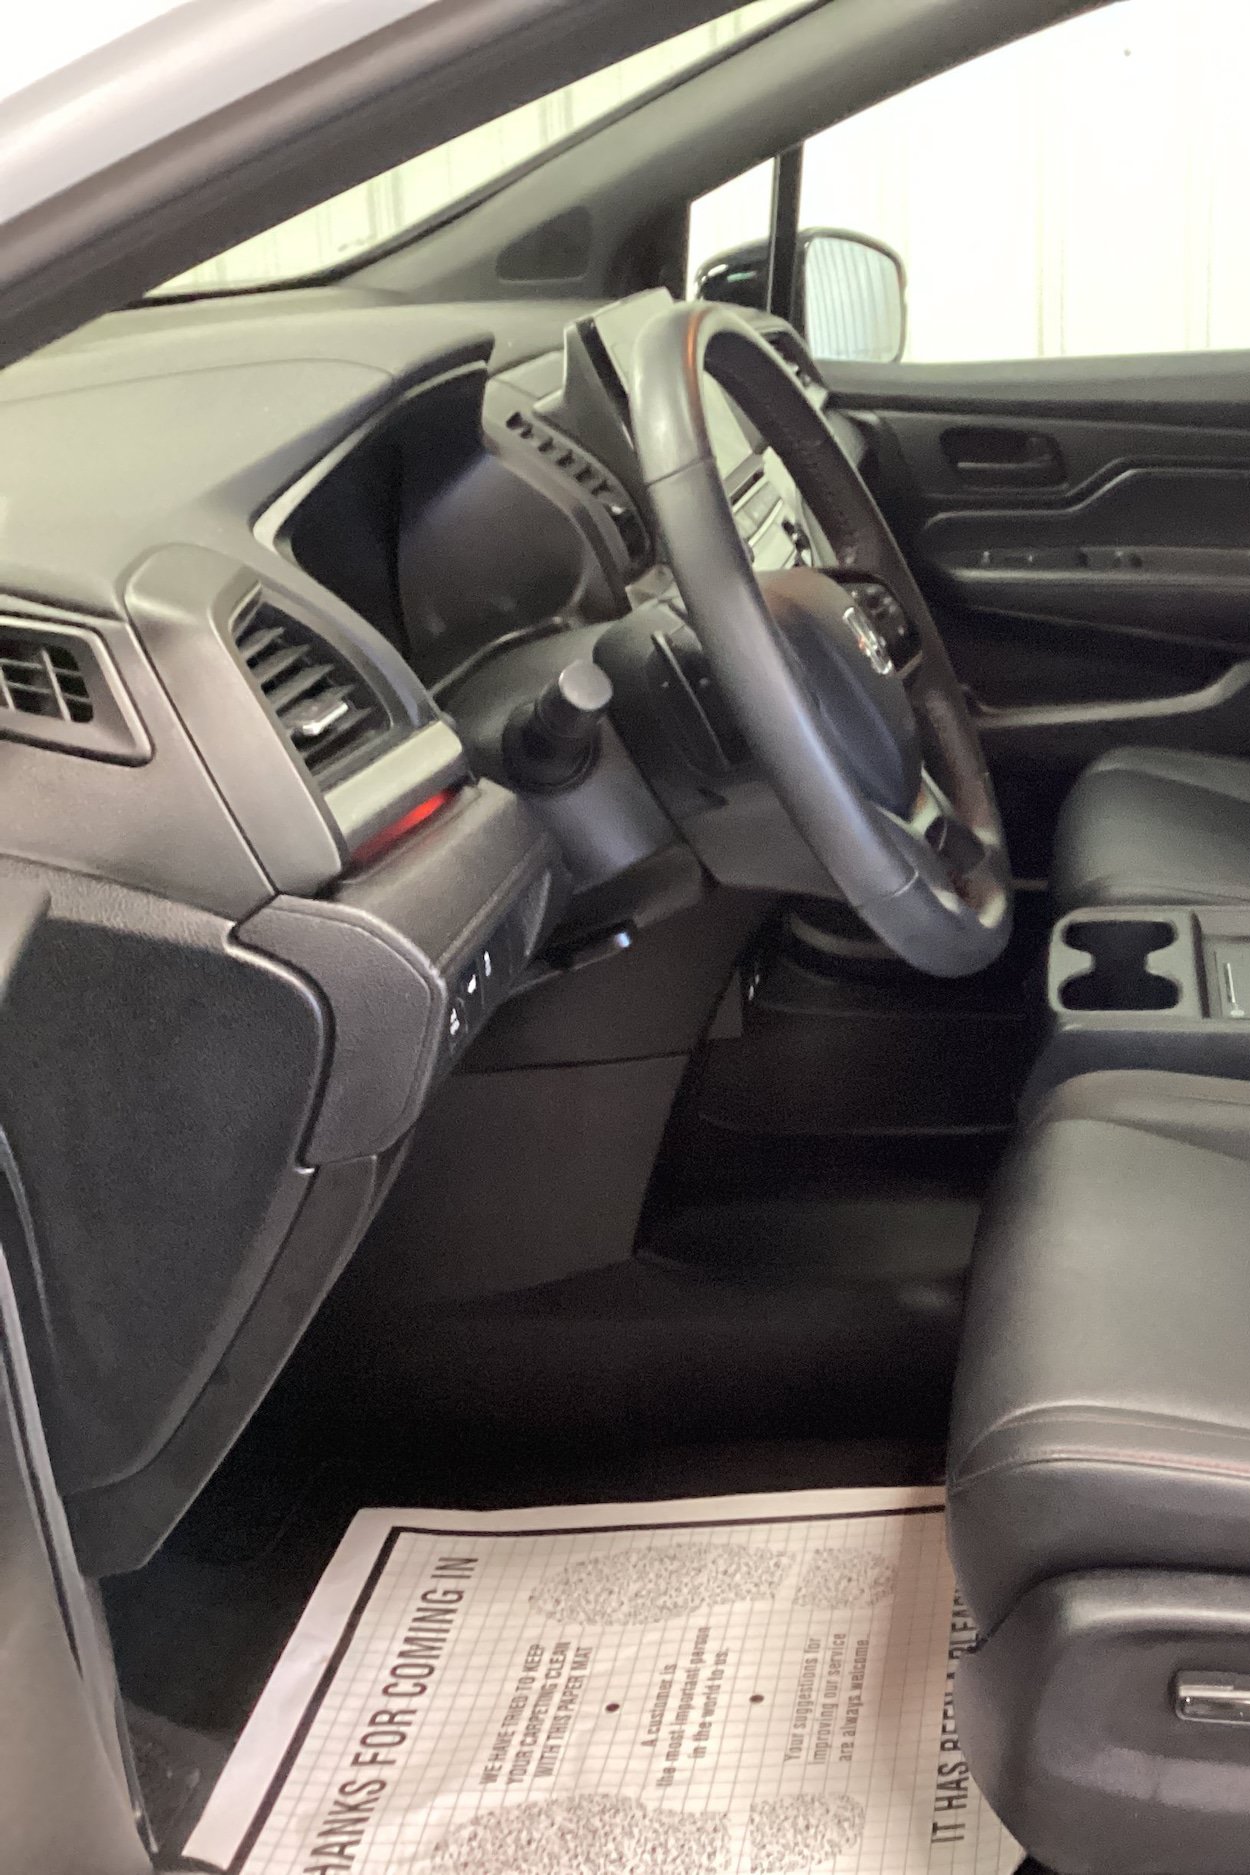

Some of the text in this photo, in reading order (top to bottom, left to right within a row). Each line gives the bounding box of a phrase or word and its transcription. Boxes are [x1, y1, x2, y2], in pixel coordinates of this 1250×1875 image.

[640, 1664, 677, 1747] A customer is
[656, 1627, 711, 1787] the most important person
[701, 1684, 721, 1718] world
[707, 1669, 724, 1681] to
[784, 1638, 821, 1762] Your suggestions for
[807, 1633, 846, 1765] improving our service
[303, 1557, 479, 1875] HANKS FOR COMING IN
[479, 1644, 546, 1784] WE HAVE TRIED TO KEEP
[506, 1642, 571, 1785] YOUR CARPETING CLEAN
[534, 1646, 593, 1777] WITH THIS PAPER MAT
[692, 1722, 712, 1741] the
[840, 1695, 864, 1737] always
[687, 1746, 707, 1758] in
[839, 1742, 854, 1762] are
[934, 1761, 969, 1811] HAS
[931, 1821, 966, 1843] IT
